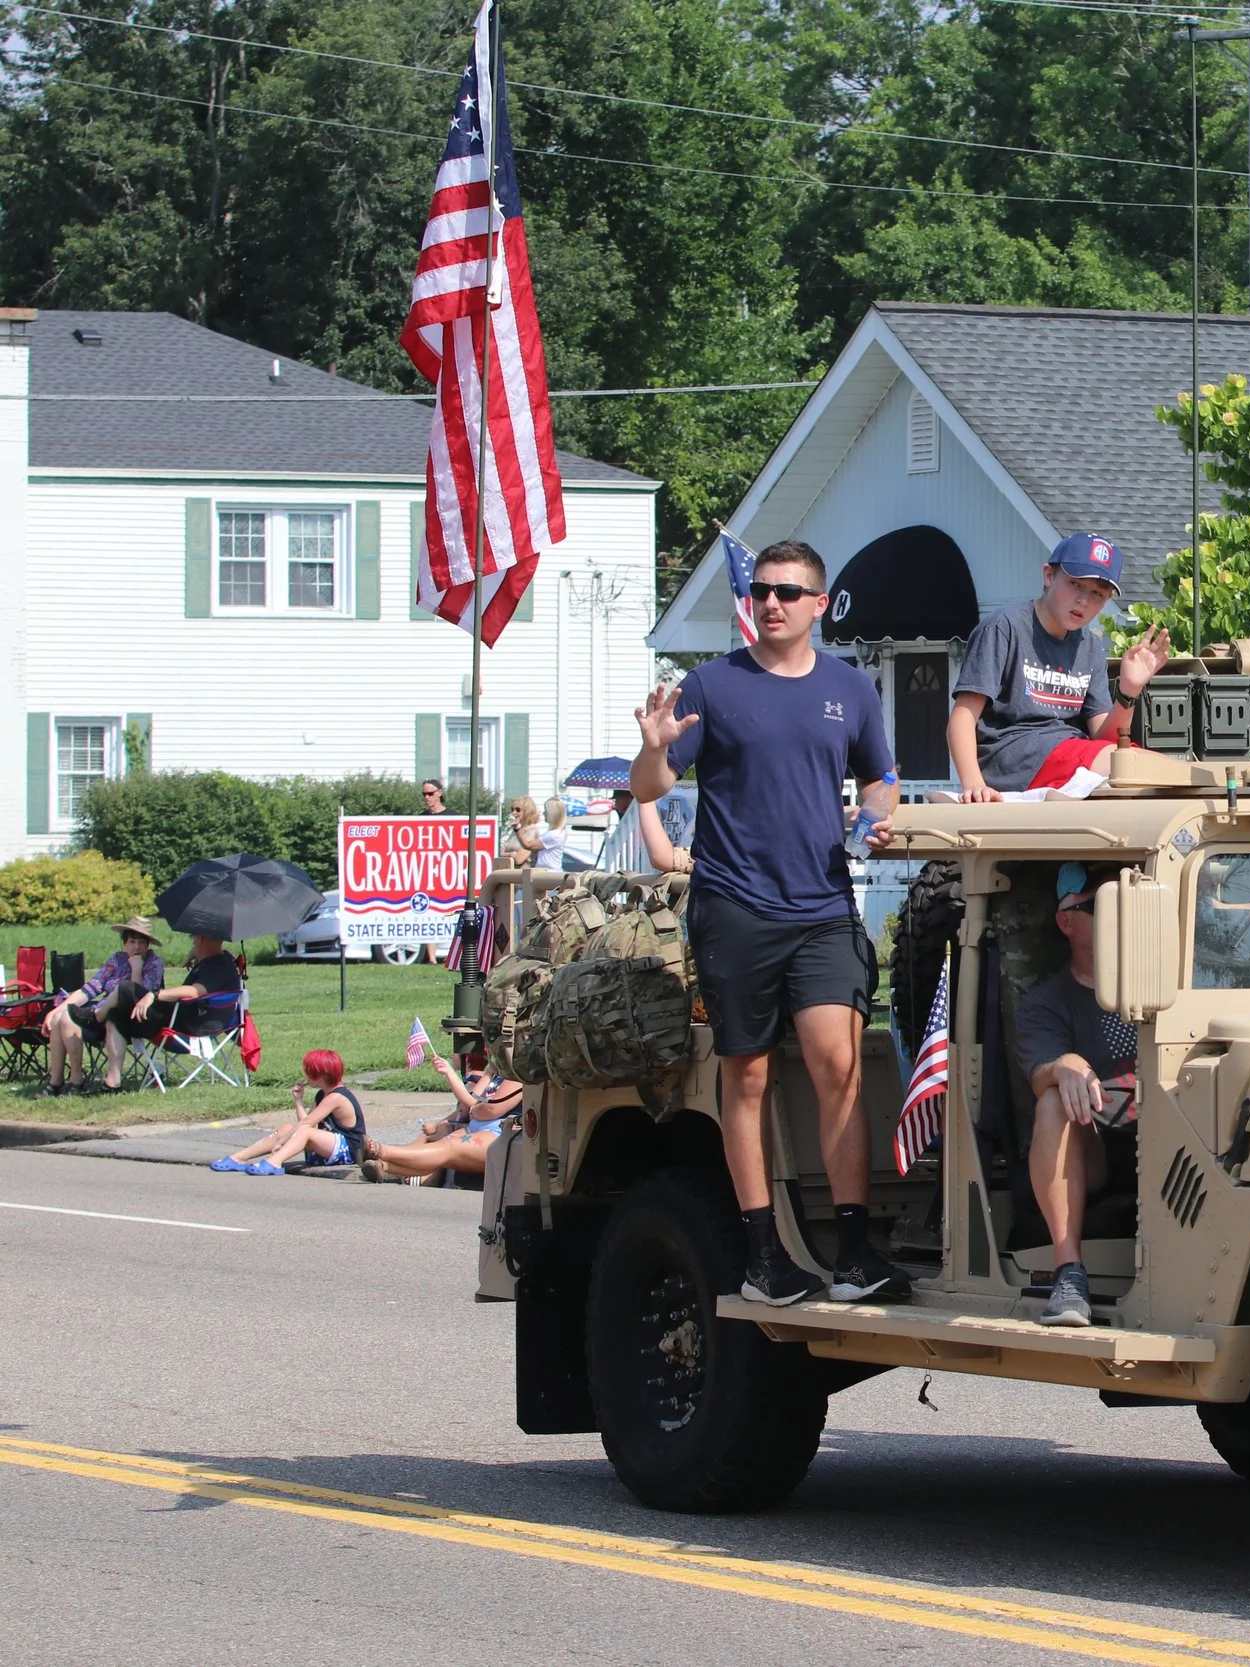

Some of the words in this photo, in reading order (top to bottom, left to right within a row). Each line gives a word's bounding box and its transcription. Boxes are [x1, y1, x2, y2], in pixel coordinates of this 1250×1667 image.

[1023, 664, 1092, 689] REMEMBE
[348, 825, 380, 838] ELECT
[386, 825, 455, 856] JOHN
[347, 924, 384, 937] STATE
